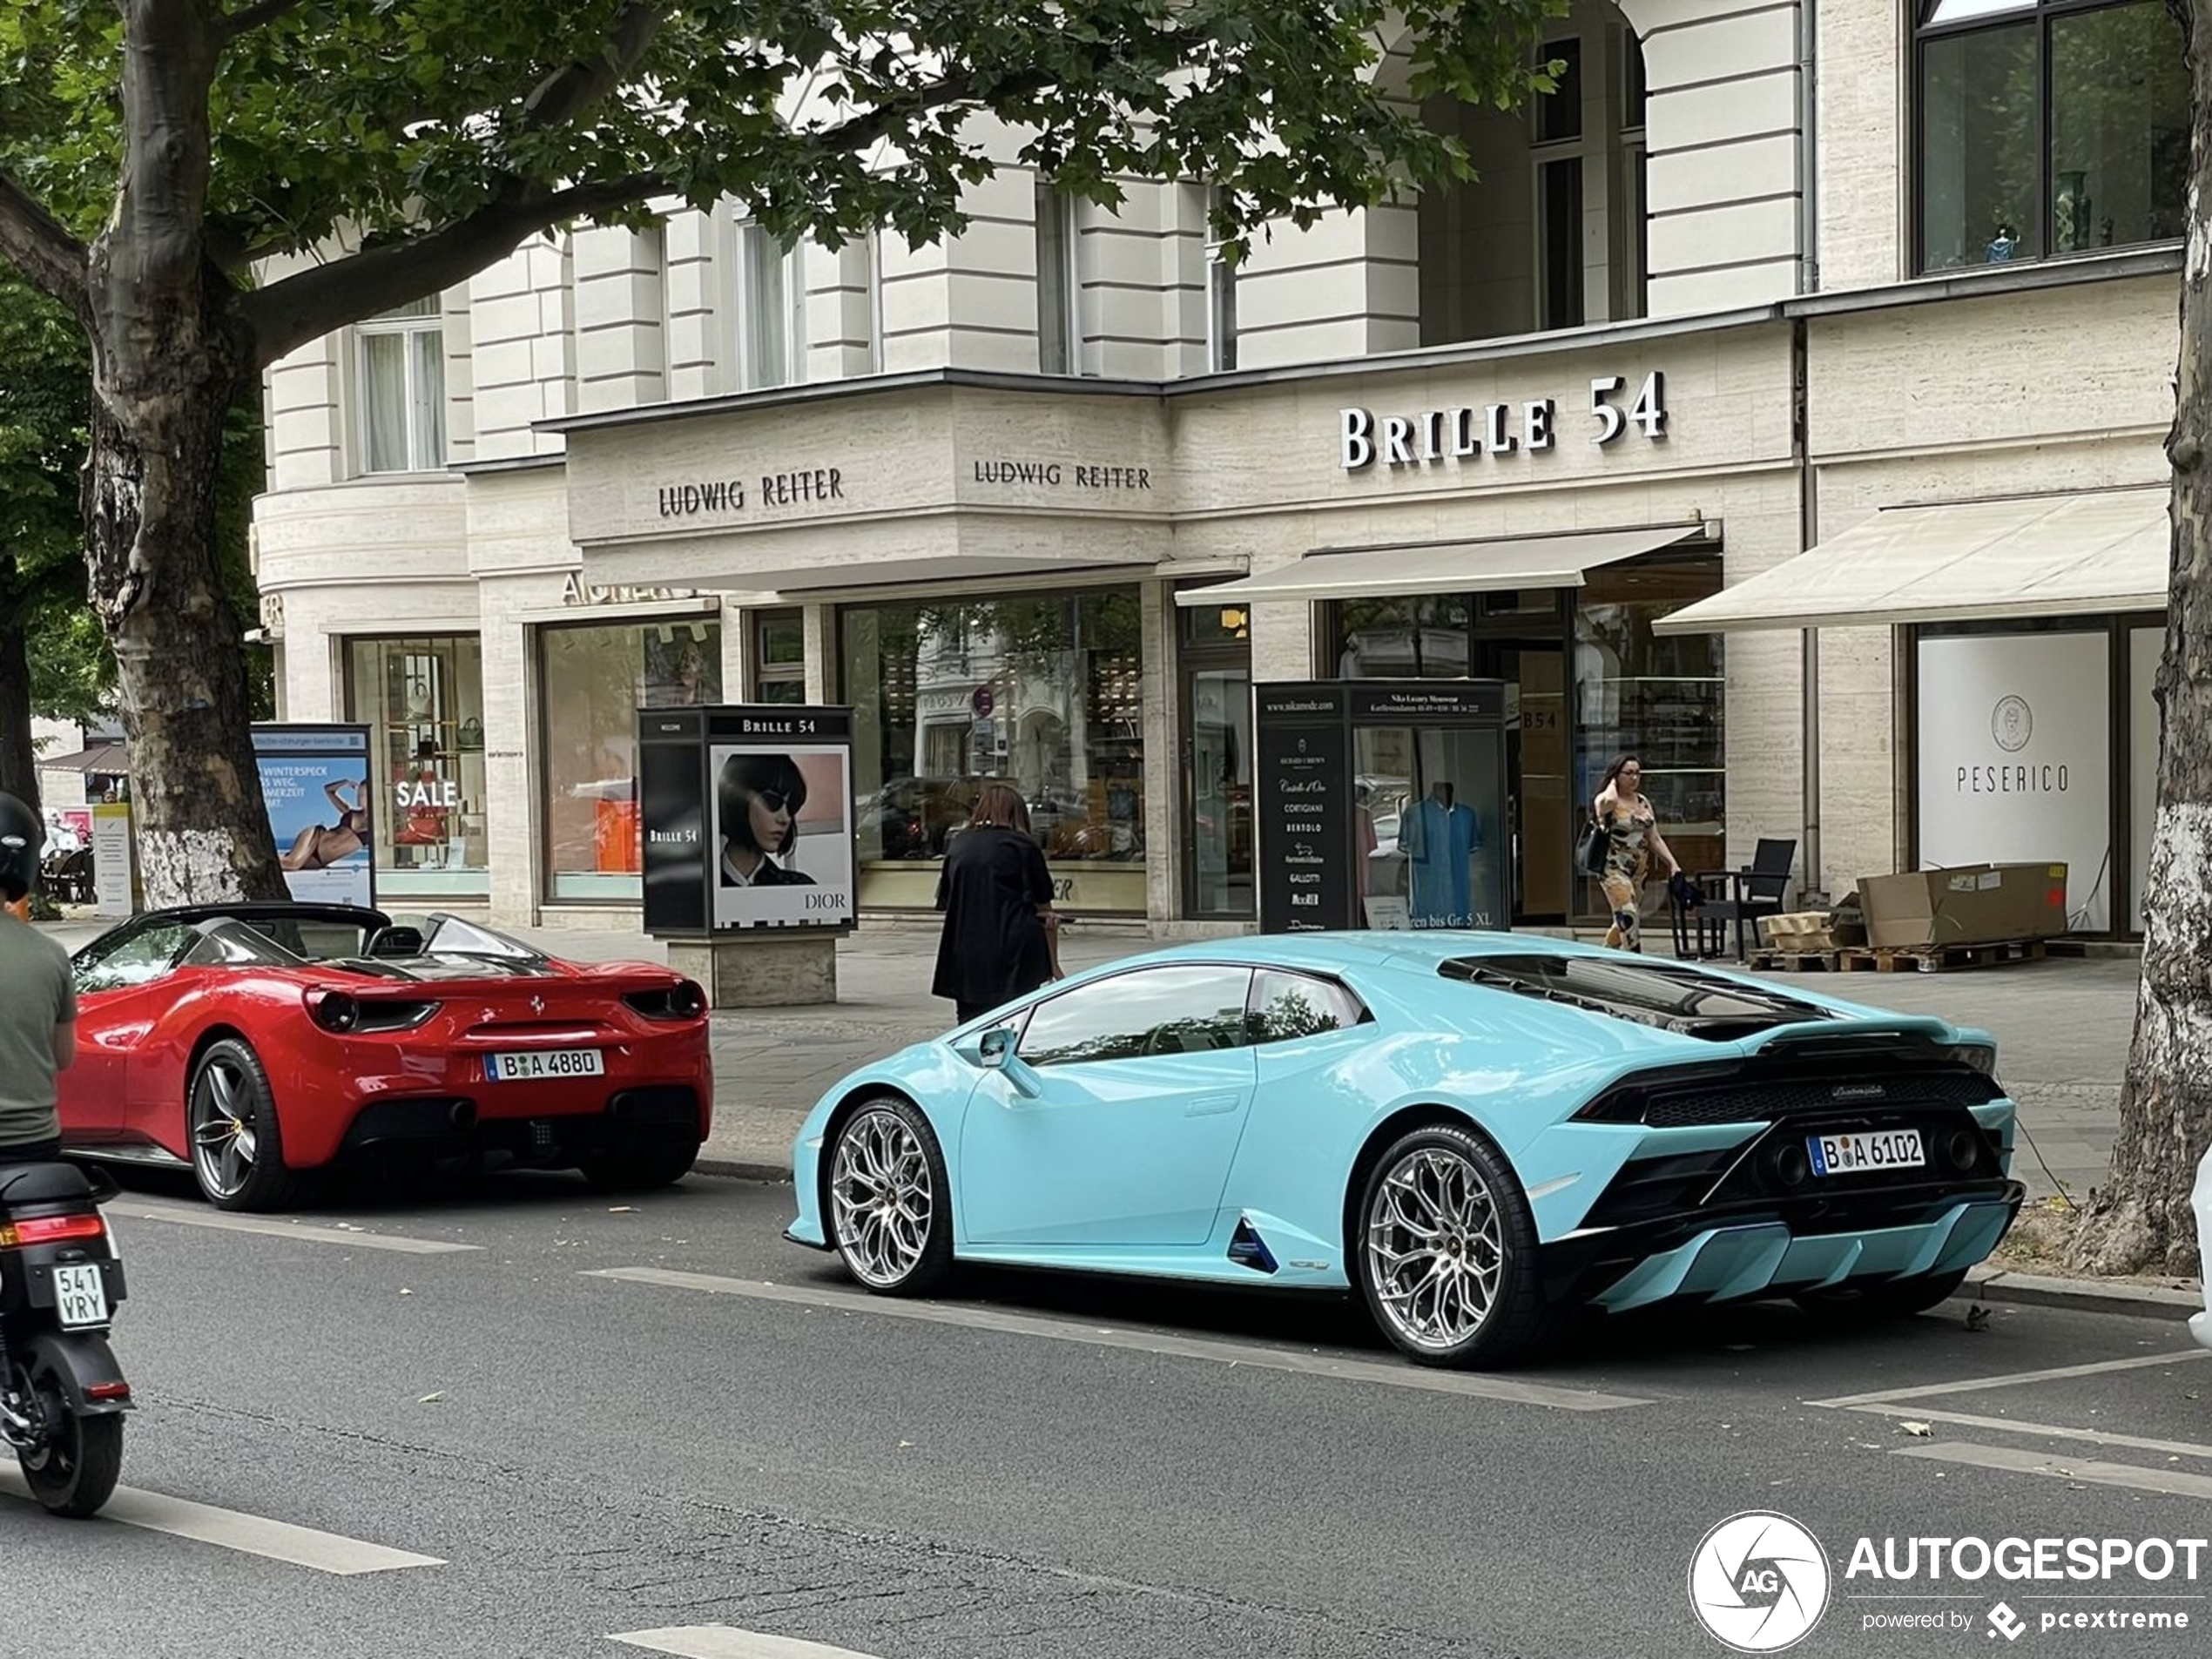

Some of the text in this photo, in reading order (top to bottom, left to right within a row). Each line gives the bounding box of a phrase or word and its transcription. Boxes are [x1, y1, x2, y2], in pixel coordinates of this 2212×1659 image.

[1339, 371, 1667, 471] BRILLE 54
[974, 461, 1150, 489] LUDWIG REITER
[659, 468, 844, 516] LUDWIG REITER
[743, 720, 815, 732] BRILLE 54
[1958, 765, 2067, 792] PESERICO
[396, 781, 456, 807] SALE
[650, 830, 697, 843] BRILLE 54
[805, 894, 846, 909] DIOR
[1430, 915, 1445, 927] bis
[1447, 914, 1463, 927] Gr.
[1467, 913, 1473, 927] 5
[1476, 913, 1493, 926] XL
[59, 1268, 97, 1292] 541
[63, 1293, 99, 1319] VRY
